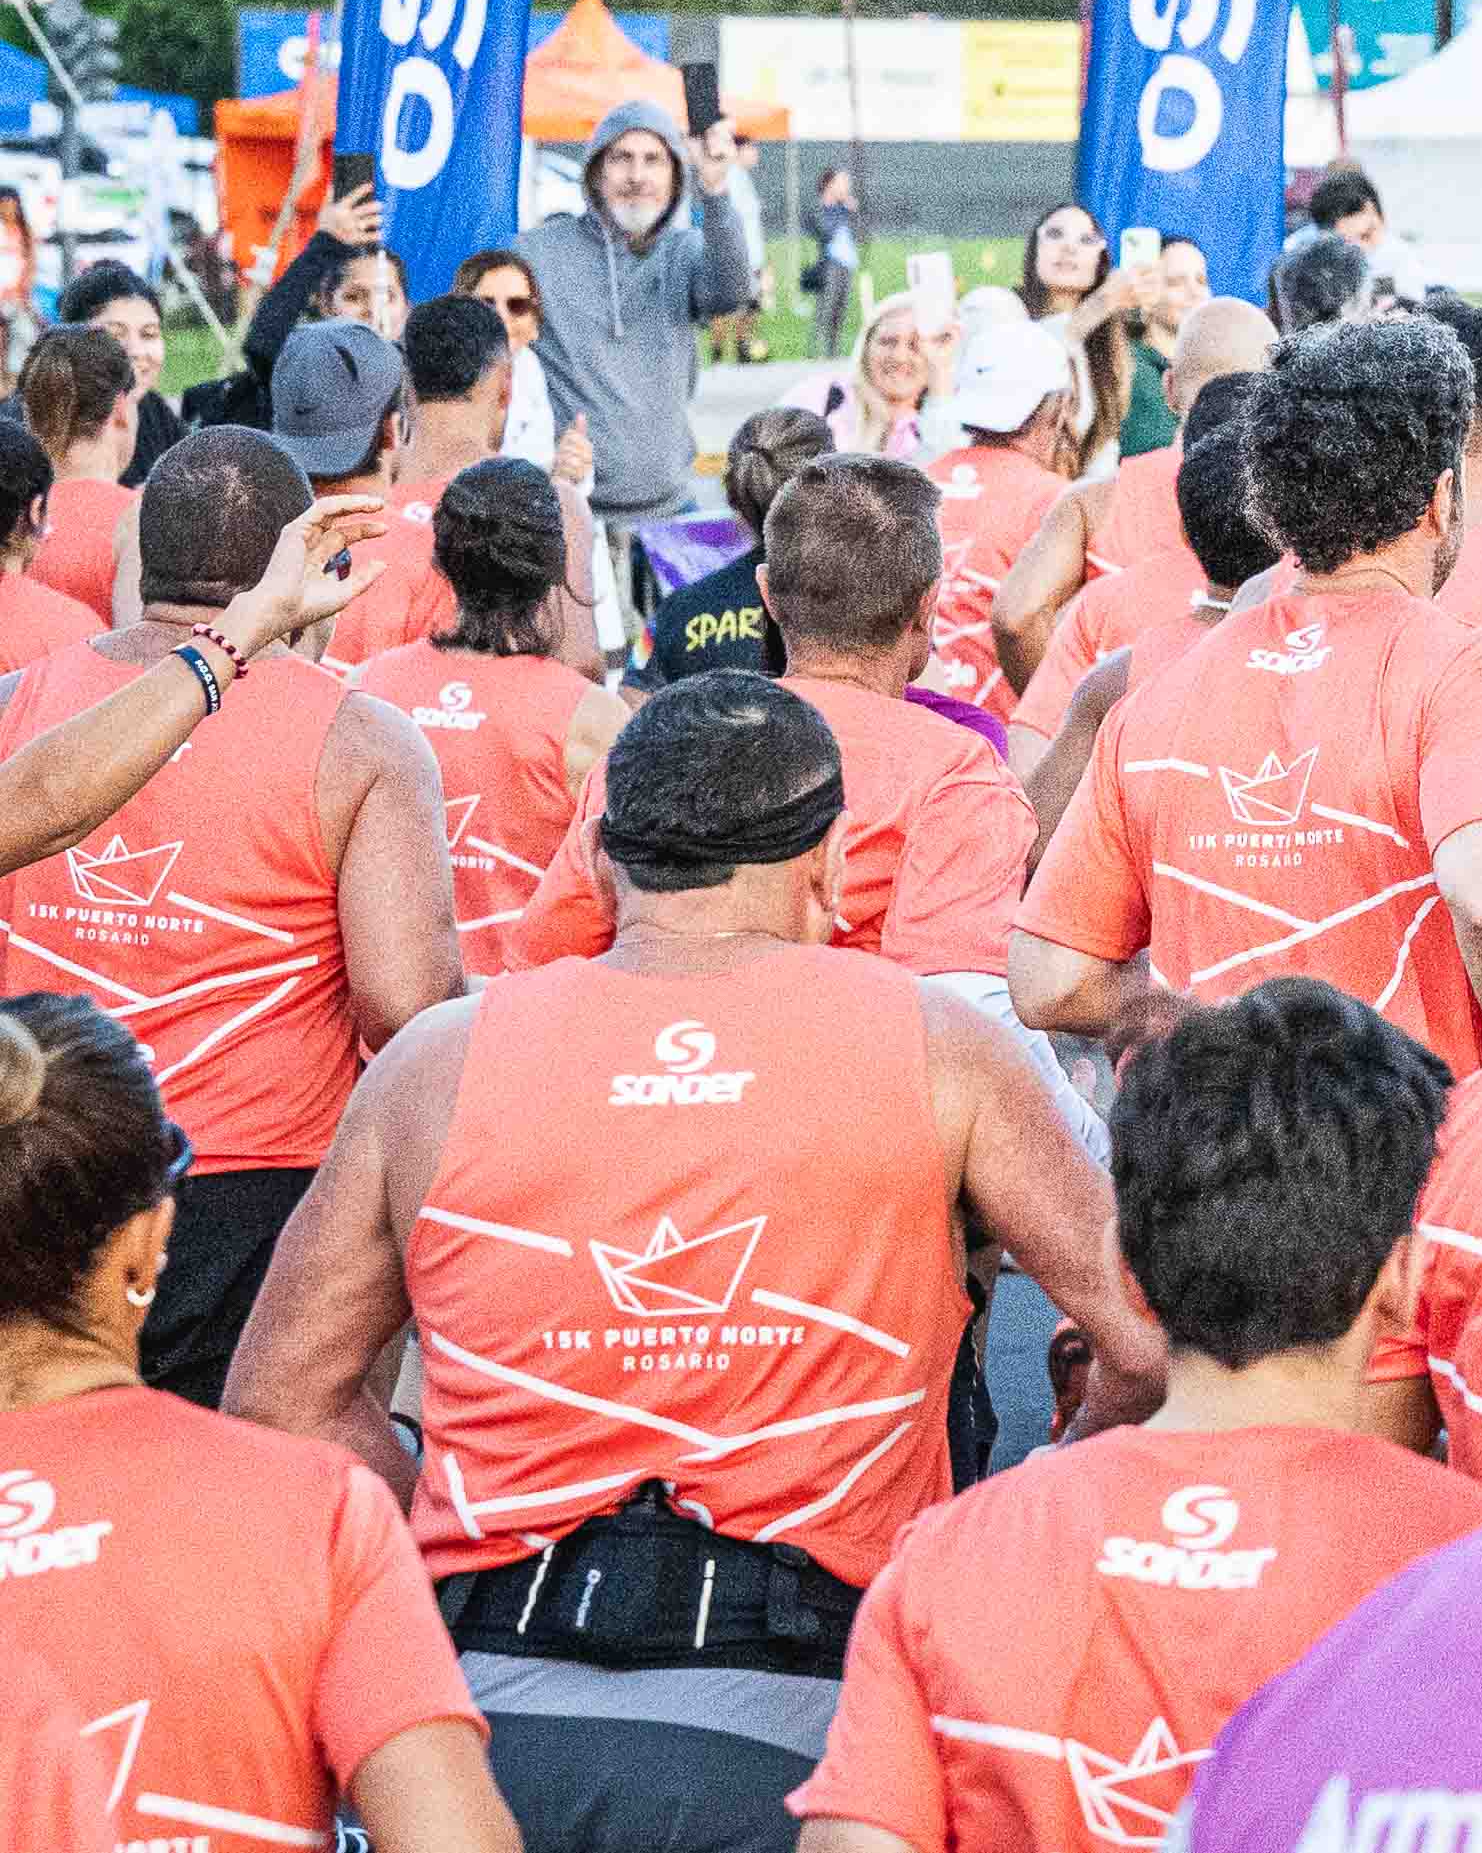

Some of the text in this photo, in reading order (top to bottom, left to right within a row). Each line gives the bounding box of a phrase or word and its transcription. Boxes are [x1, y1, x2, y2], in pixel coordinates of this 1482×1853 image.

[686, 606, 765, 652] SPAR
[66, 907, 138, 928] PUERTO
[145, 915, 205, 934] NORTE
[75, 927, 150, 946] ROSARIO
[542, 1325, 806, 1349] 15K PUERTO NORTE
[623, 1352, 731, 1372] ROSARIO
